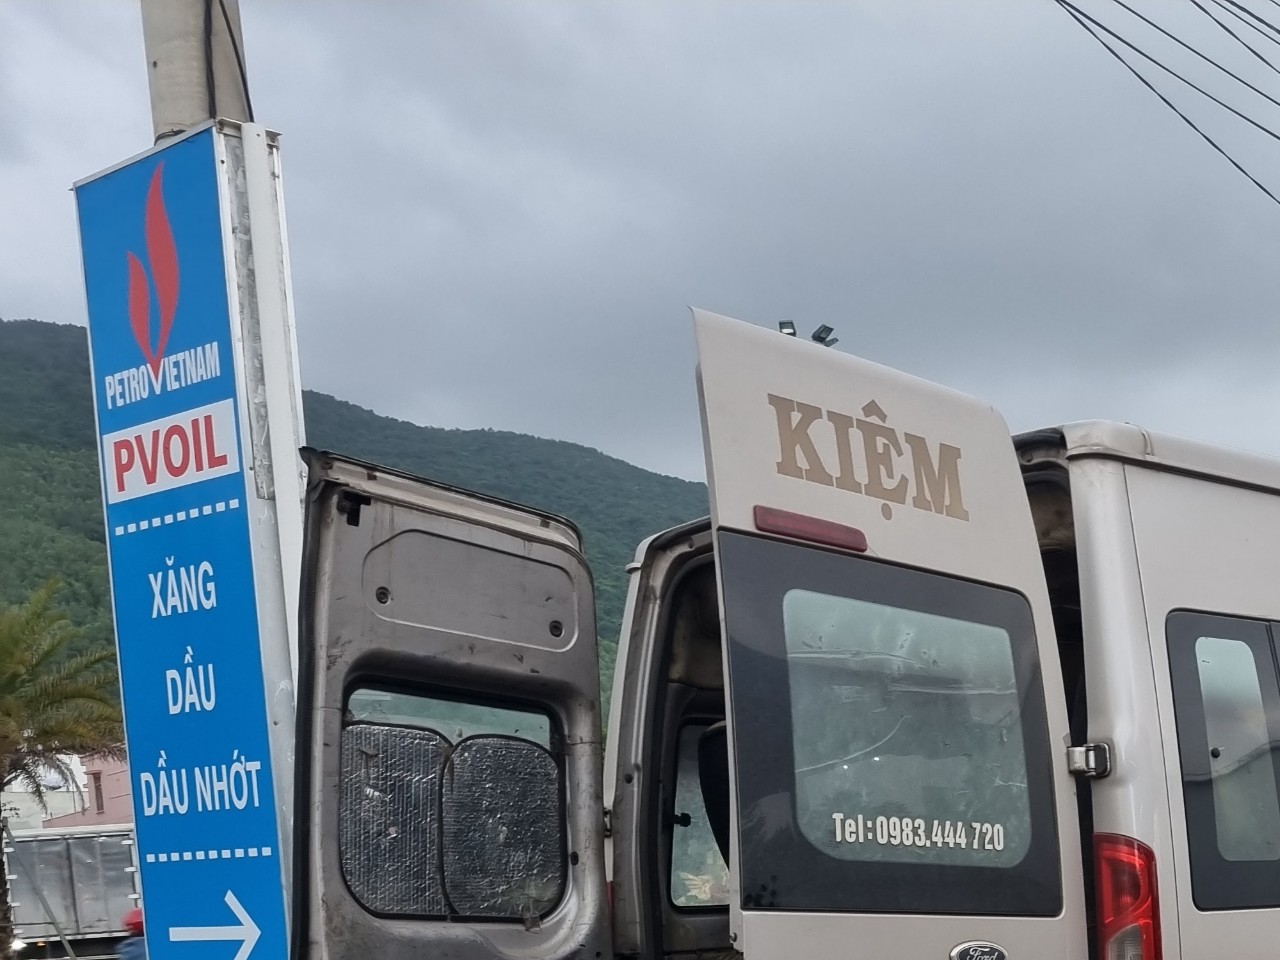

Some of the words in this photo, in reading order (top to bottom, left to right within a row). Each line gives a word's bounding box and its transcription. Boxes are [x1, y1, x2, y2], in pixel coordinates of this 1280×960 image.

[104, 341, 221, 410] PETROVIETNAM
[113, 414, 228, 493] PVOIL
[767, 393, 970, 522] KIỆM
[148, 555, 217, 619] XĂNG
[165, 645, 216, 715] DẦU
[140, 750, 189, 817] DẦU
[194, 749, 262, 812] NHỚT
[971, 822, 1004, 850] 720
